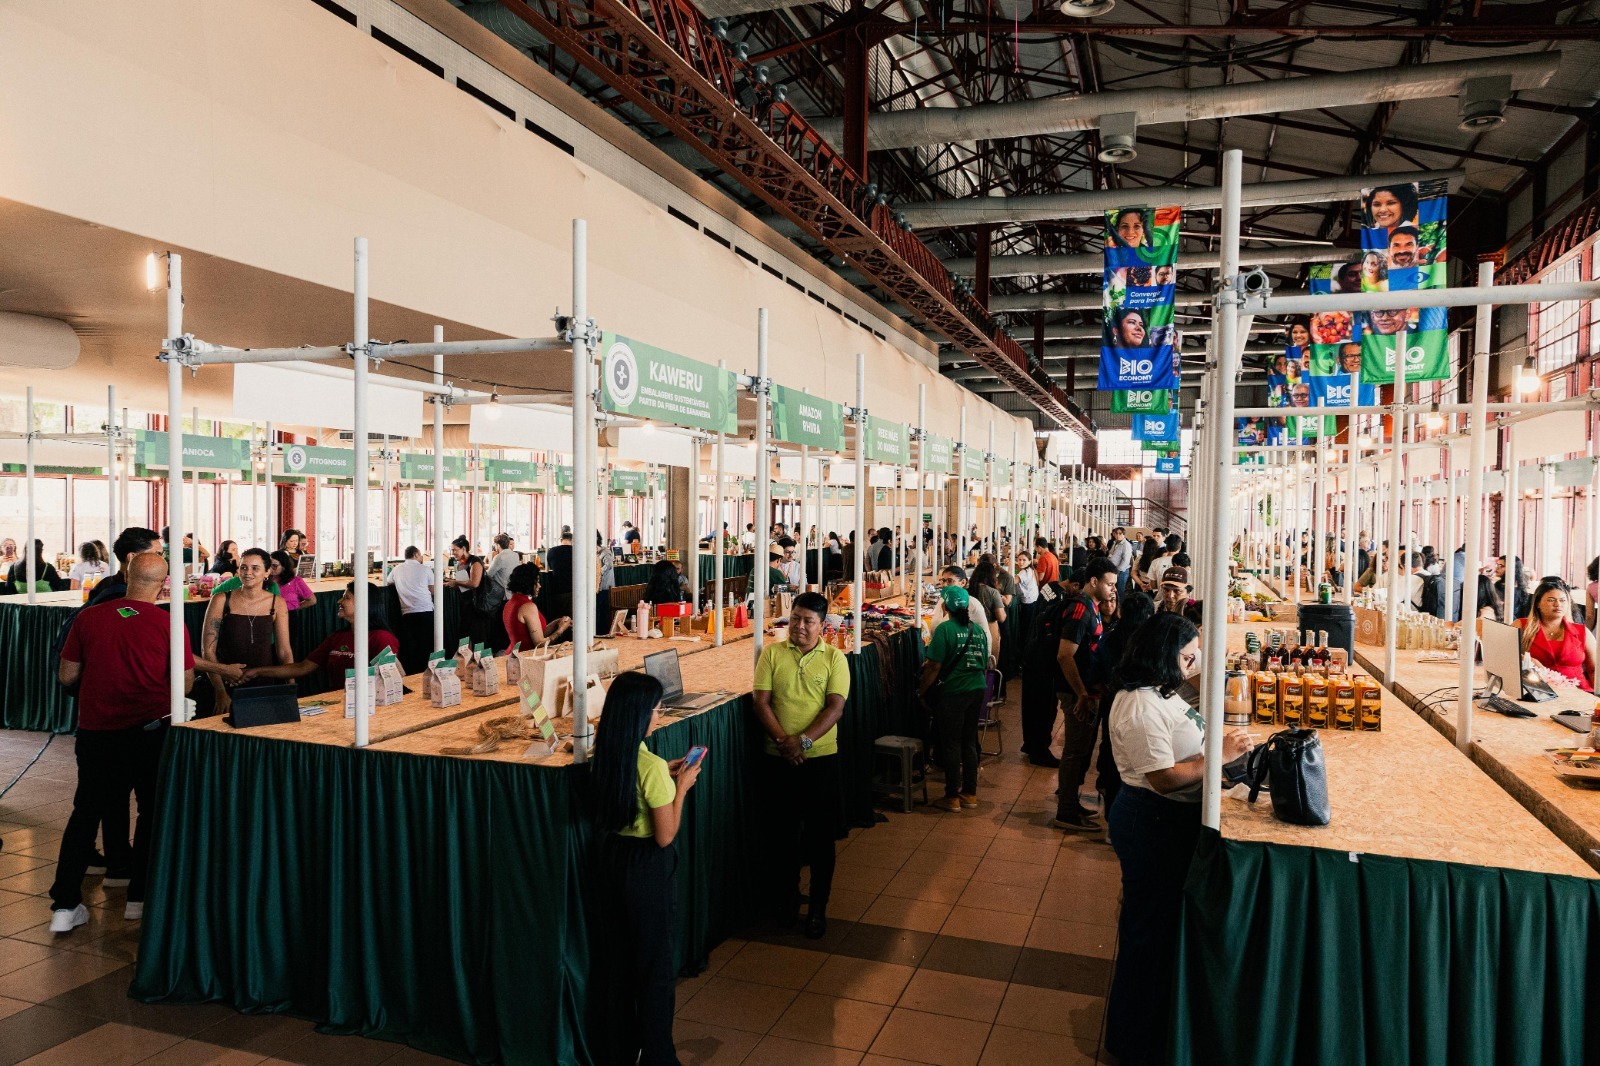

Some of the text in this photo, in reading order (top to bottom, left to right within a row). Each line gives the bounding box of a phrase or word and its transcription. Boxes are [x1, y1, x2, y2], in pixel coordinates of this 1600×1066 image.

[1385, 346, 1425, 366] BO
[1119, 357, 1153, 375] BIO
[1385, 363, 1425, 372] ECOMY
[649, 360, 703, 393] KAWERU
[640, 385, 674, 401] EMBALAGENS
[1127, 389, 1153, 404] BIO
[638, 396, 657, 408] PARTIR
[657, 400, 665, 409] DA
[665, 402, 680, 413] FIBRA
[680, 405, 686, 414] DE
[798, 403, 822, 421] AMAZON
[1144, 419, 1166, 431] BIO
[181, 447, 215, 457] ANIOCA
[309, 457, 347, 466] FITOGNOSIS
